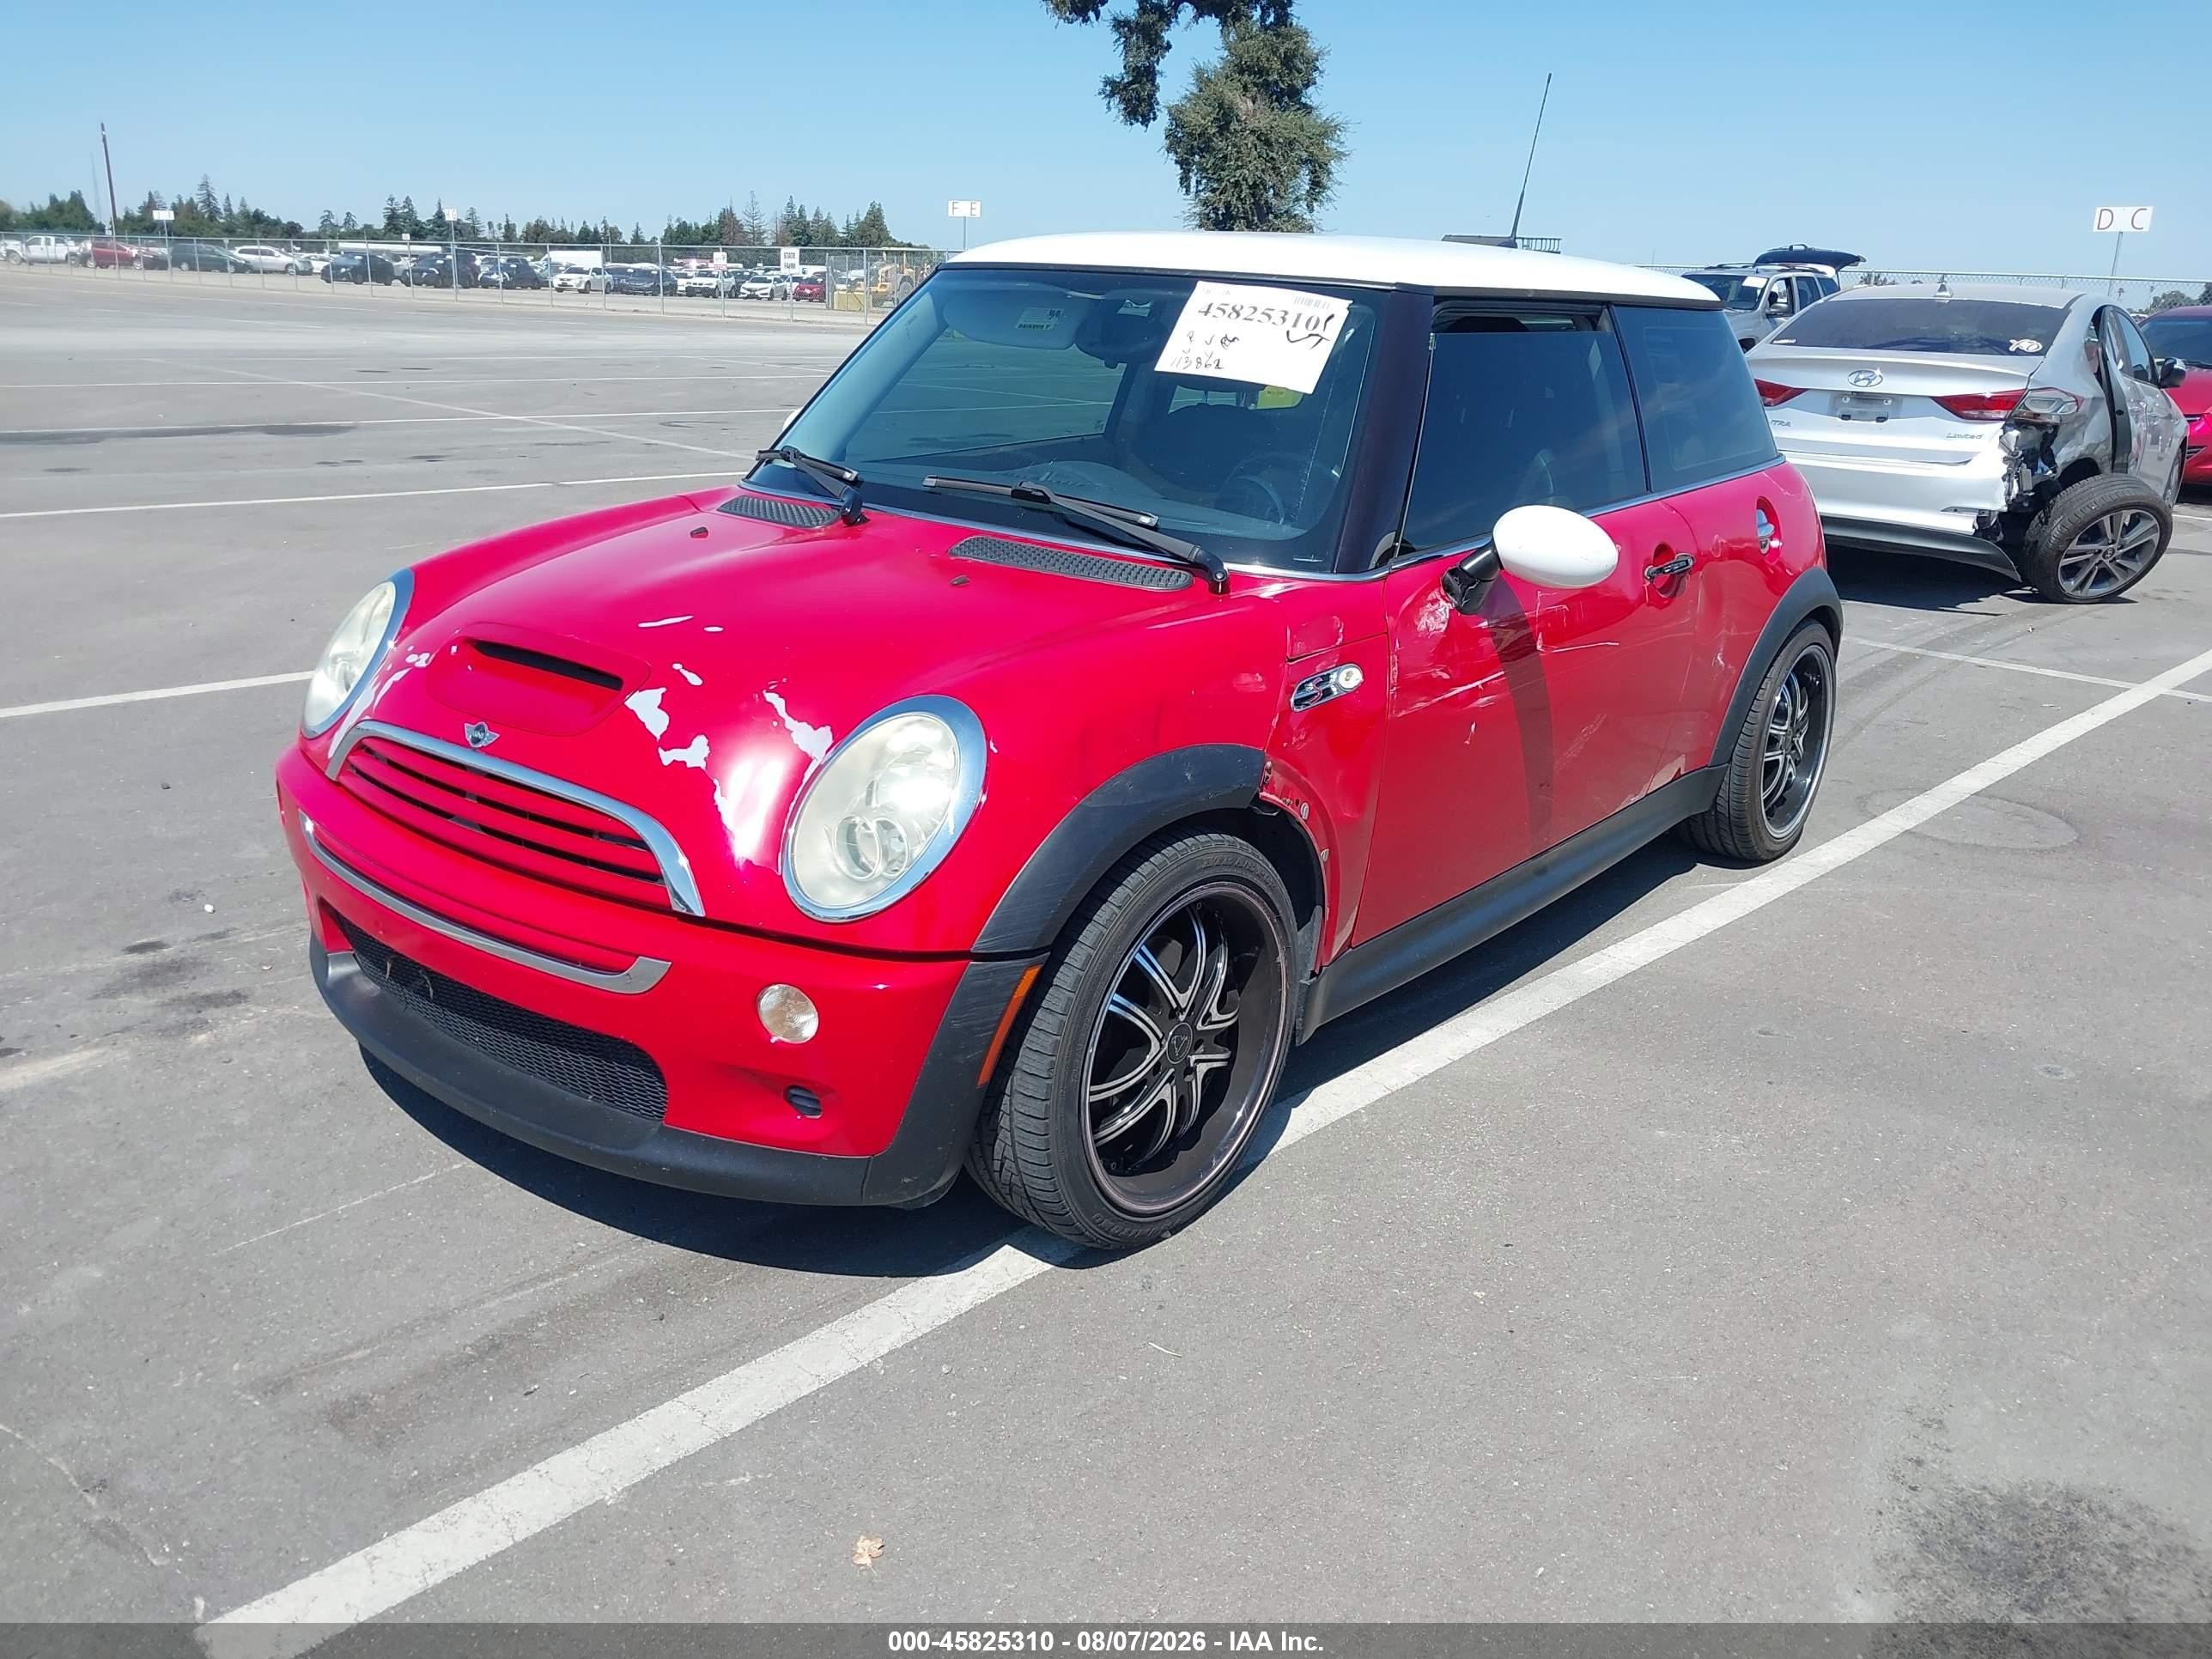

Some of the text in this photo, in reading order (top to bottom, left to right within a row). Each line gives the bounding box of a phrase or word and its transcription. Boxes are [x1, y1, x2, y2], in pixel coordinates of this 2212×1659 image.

[952, 201, 977, 216] F E
[2097, 208, 2148, 230] D C
[1197, 301, 1322, 331] 45825310
